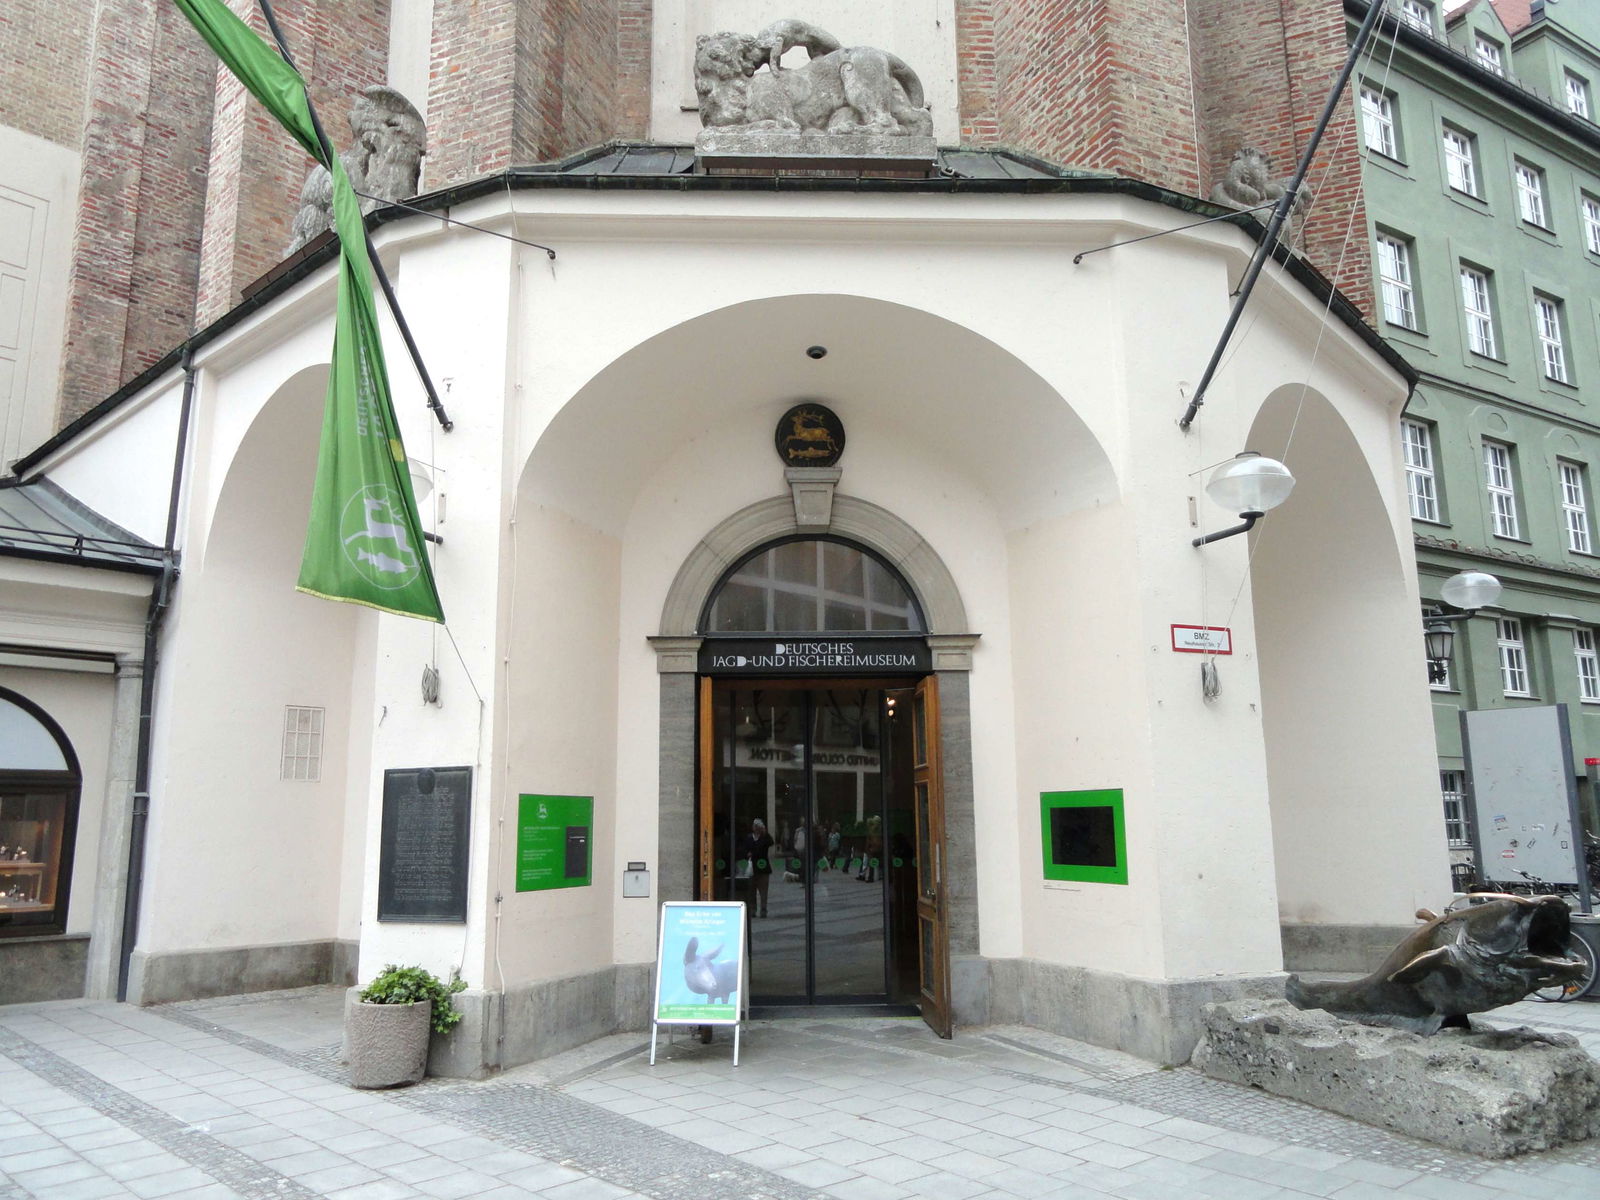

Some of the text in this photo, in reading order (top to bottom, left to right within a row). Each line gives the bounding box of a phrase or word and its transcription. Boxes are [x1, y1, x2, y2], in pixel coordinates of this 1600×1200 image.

[1193, 632, 1209, 640] BMZ
[775, 643, 854, 654] DEUTSCHES
[712, 654, 917, 667] JAGD-UND FISCHEREIMUSEUM
